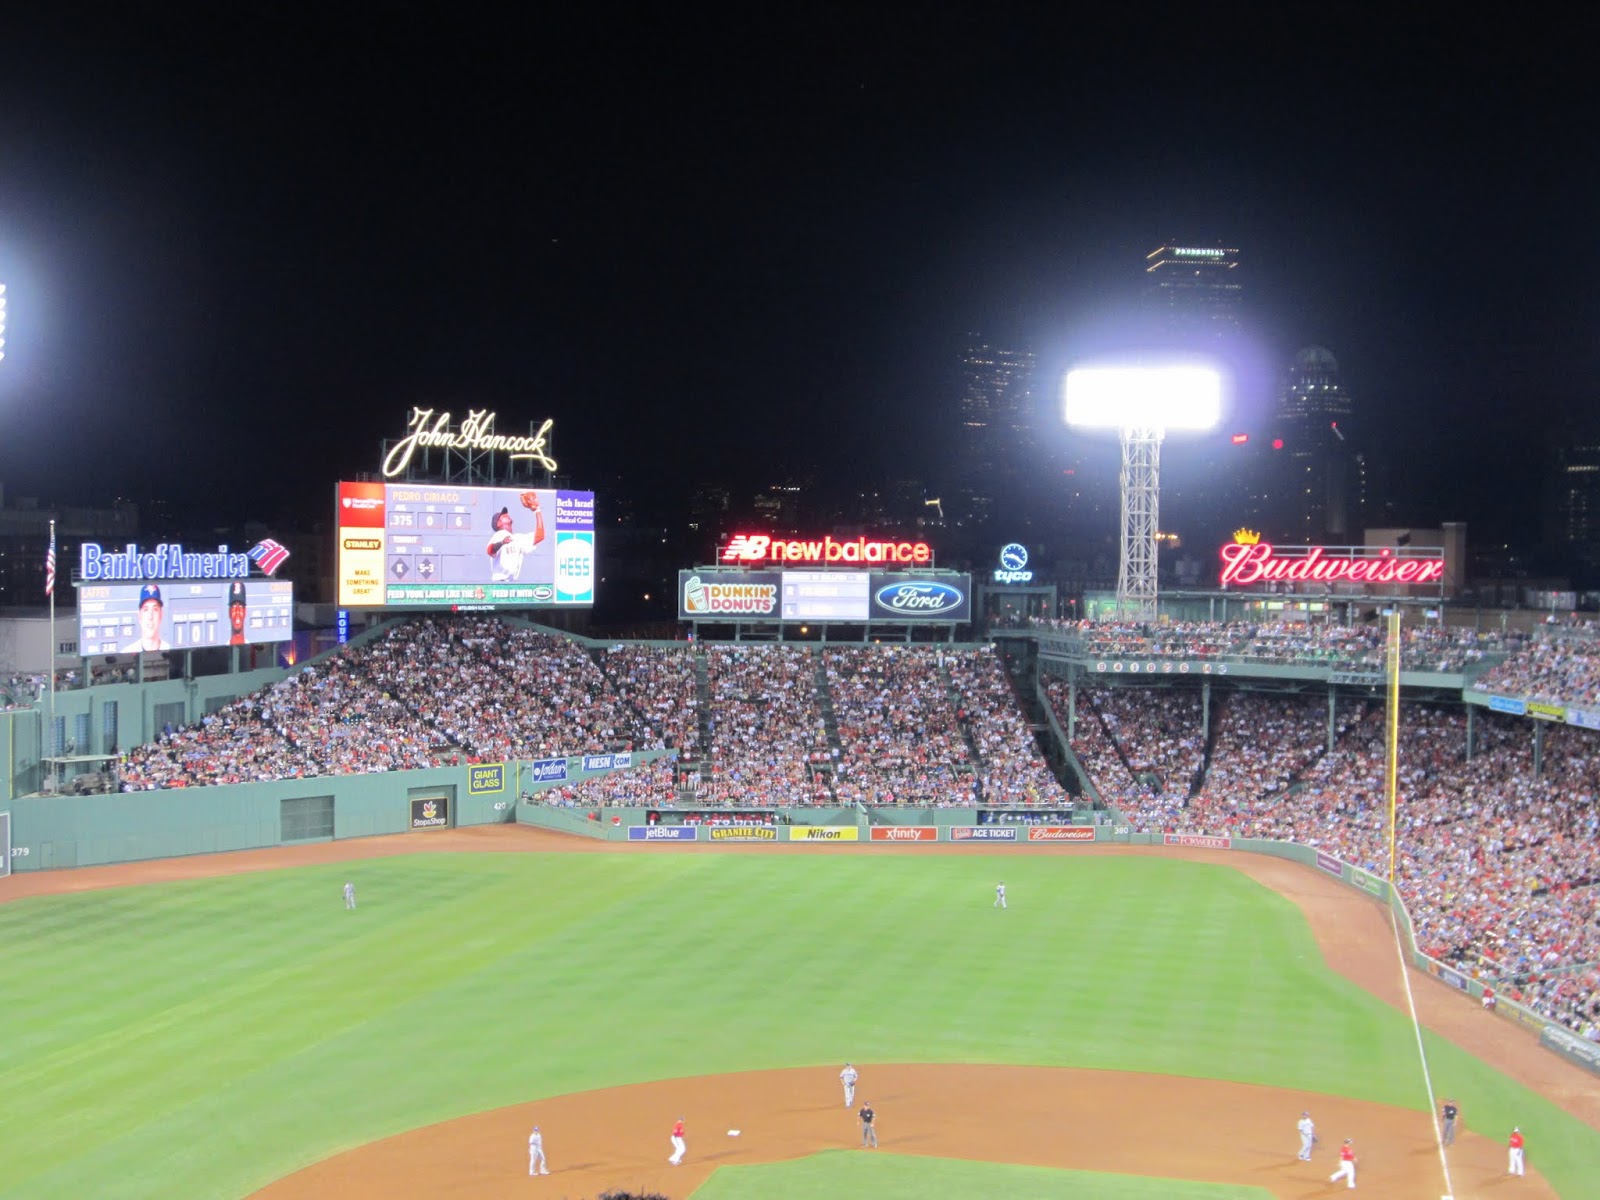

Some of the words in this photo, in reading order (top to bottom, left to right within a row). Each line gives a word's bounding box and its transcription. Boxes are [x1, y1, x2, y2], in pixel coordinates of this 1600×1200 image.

[382, 406, 459, 477] John
[454, 408, 557, 472] Hancock
[393, 491, 421, 501] PEDRO
[424, 492, 459, 503] CIRIACO
[556, 498, 573, 507] Beth
[574, 499, 594, 508] Israel
[556, 507, 594, 517] Deaconess
[426, 515, 434, 526] 0
[455, 516, 463, 527] 6
[556, 516, 577, 524] Medical
[344, 540, 380, 549] STANLEY
[771, 540, 824, 561] new
[824, 535, 930, 562] balance
[81, 543, 145, 579] Bank
[146, 543, 168, 578] of
[168, 544, 249, 578] America
[559, 557, 590, 577] HESS
[1221, 543, 1444, 584] Budweiser
[396, 563, 403, 573] K
[994, 569, 1033, 584] tyco
[387, 590, 405, 599] FEED
[711, 586, 774, 598] DUNKIN'
[892, 585, 946, 608] Ford
[711, 599, 771, 610] DONUTS
[588, 756, 612, 770] NESN
[474, 769, 499, 780] GIANT
[473, 779, 500, 789] GLASS
[494, 802, 506, 810] 420
[645, 827, 680, 839] jetBlue
[712, 828, 753, 839] GRANITE
[754, 827, 776, 838] CITY
[807, 829, 841, 839] Nikon
[886, 828, 921, 841] xfinity
[972, 829, 988, 838] ACE
[988, 829, 1015, 838] TICKET
[1030, 828, 1093, 840] Budweiser
[1114, 827, 1129, 835] 380
[1180, 835, 1224, 848] FOXWOODS
[11, 847, 30, 857] 379
